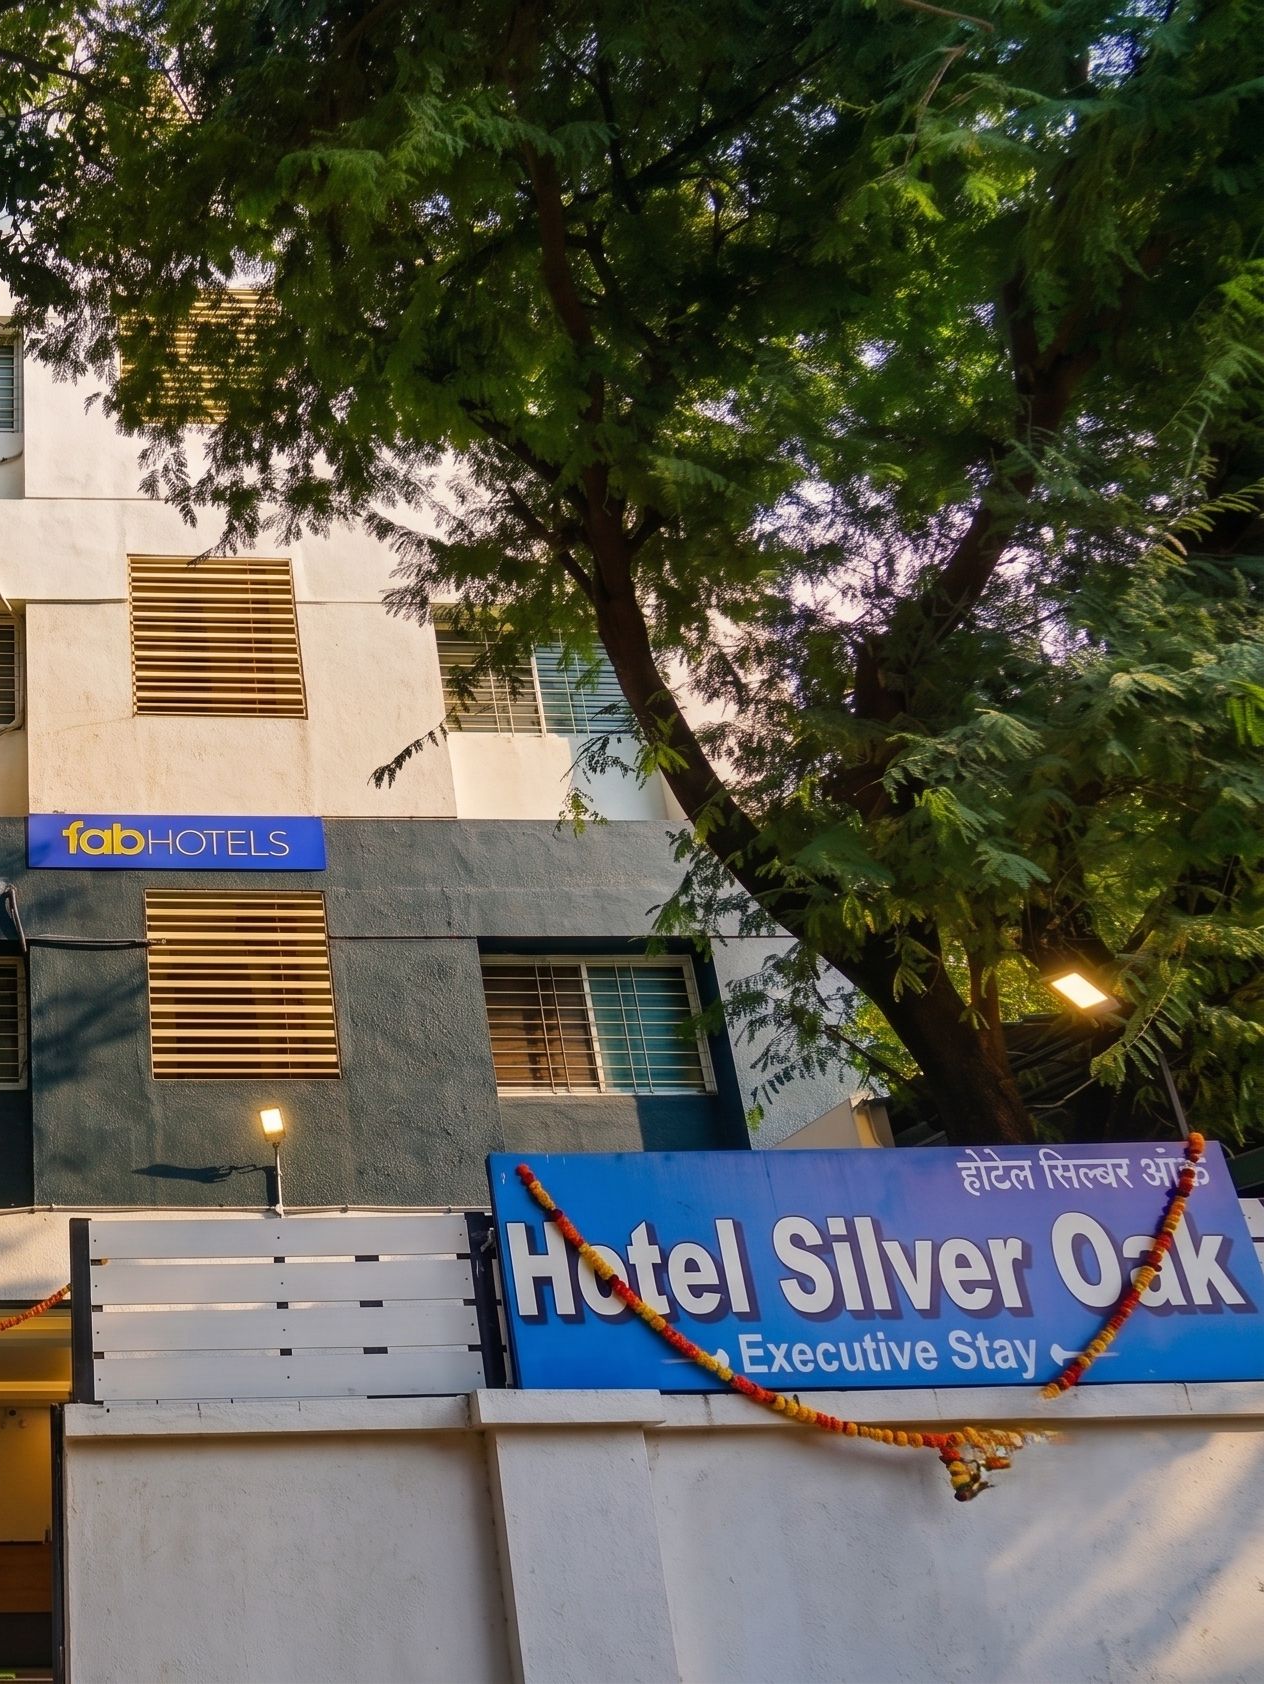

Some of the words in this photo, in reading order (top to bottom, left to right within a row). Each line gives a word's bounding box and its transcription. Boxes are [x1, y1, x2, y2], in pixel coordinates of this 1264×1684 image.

[62, 820, 290, 856] fabHOTELS
[956, 1148, 1035, 1197] होटेल
[506, 1217, 751, 1316] Hotel
[772, 1215, 1024, 1314] Silver
[1051, 1211, 1246, 1308] Oak
[738, 1331, 938, 1374] Executive
[947, 1329, 1036, 1380] Stay
